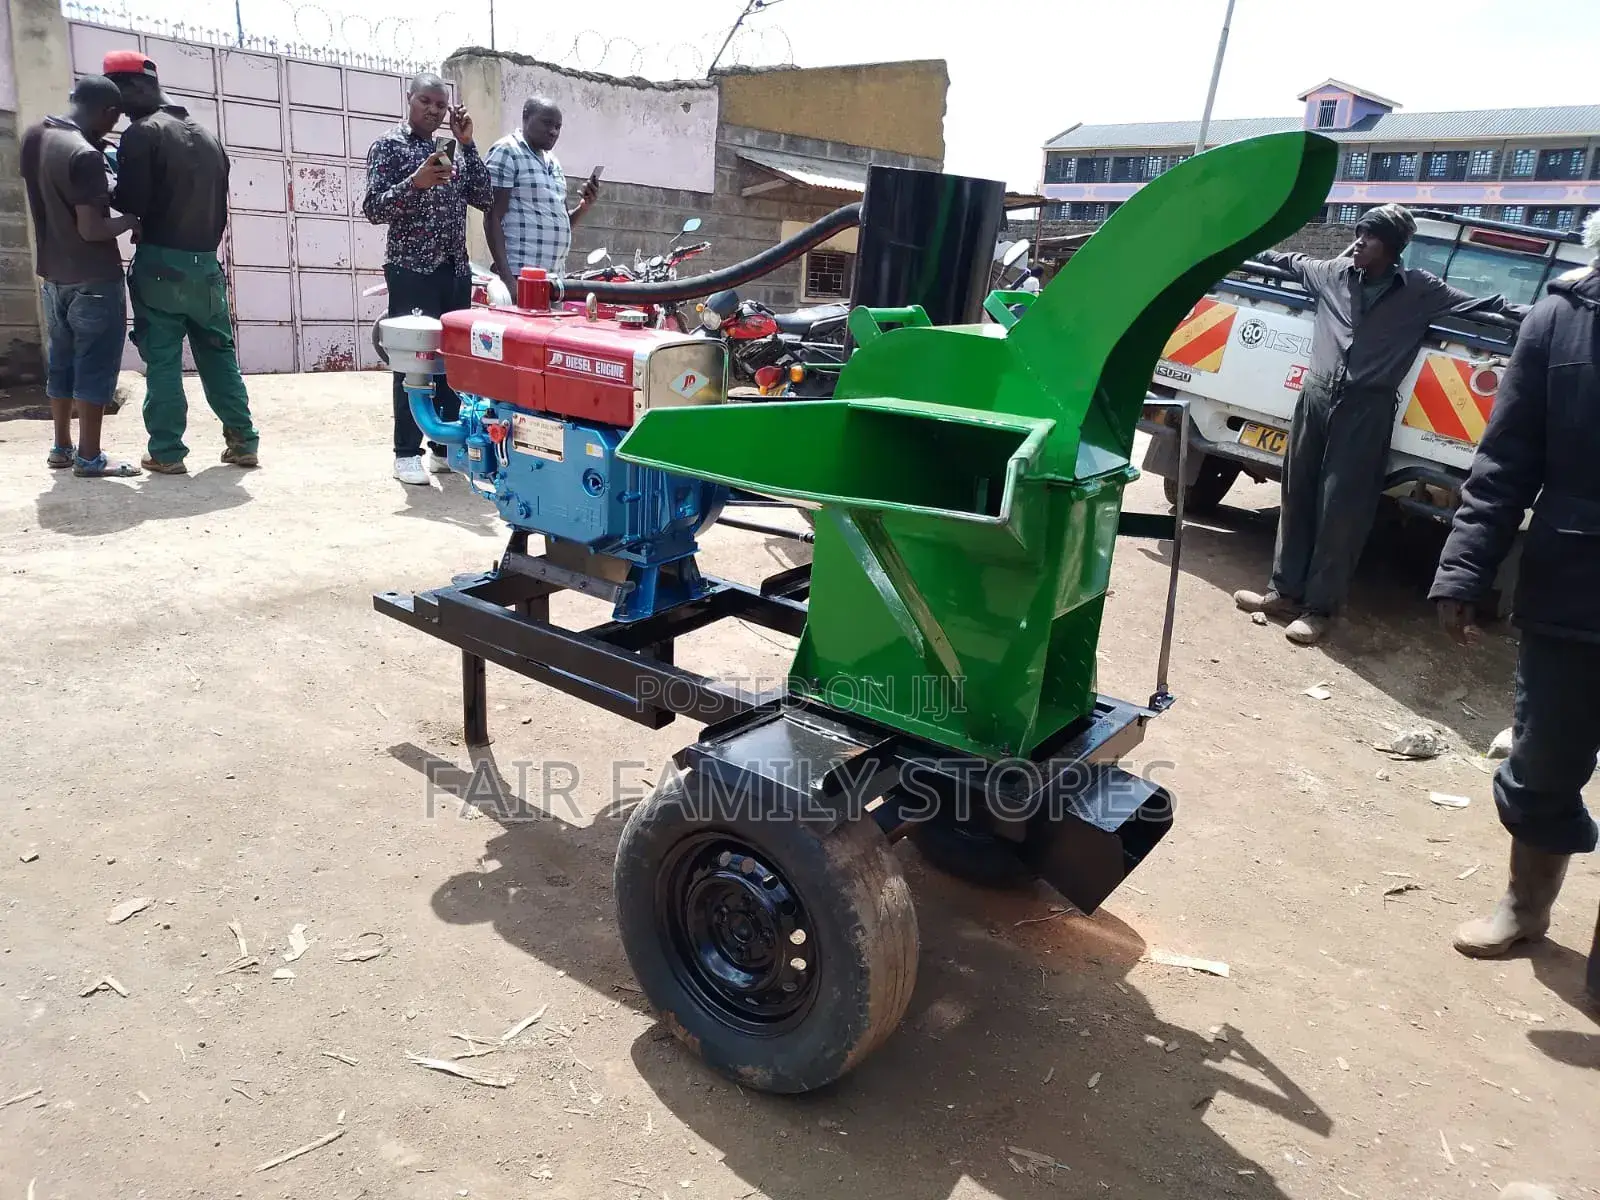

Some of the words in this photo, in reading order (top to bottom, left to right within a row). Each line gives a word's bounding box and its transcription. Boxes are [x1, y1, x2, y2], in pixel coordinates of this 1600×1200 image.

[1243, 324, 1262, 340] 80
[565, 355, 592, 375] DIESEL
[595, 361, 625, 378] ENGINE
[1156, 366, 1191, 382] ISUZU
[1256, 428, 1285, 452] KC
